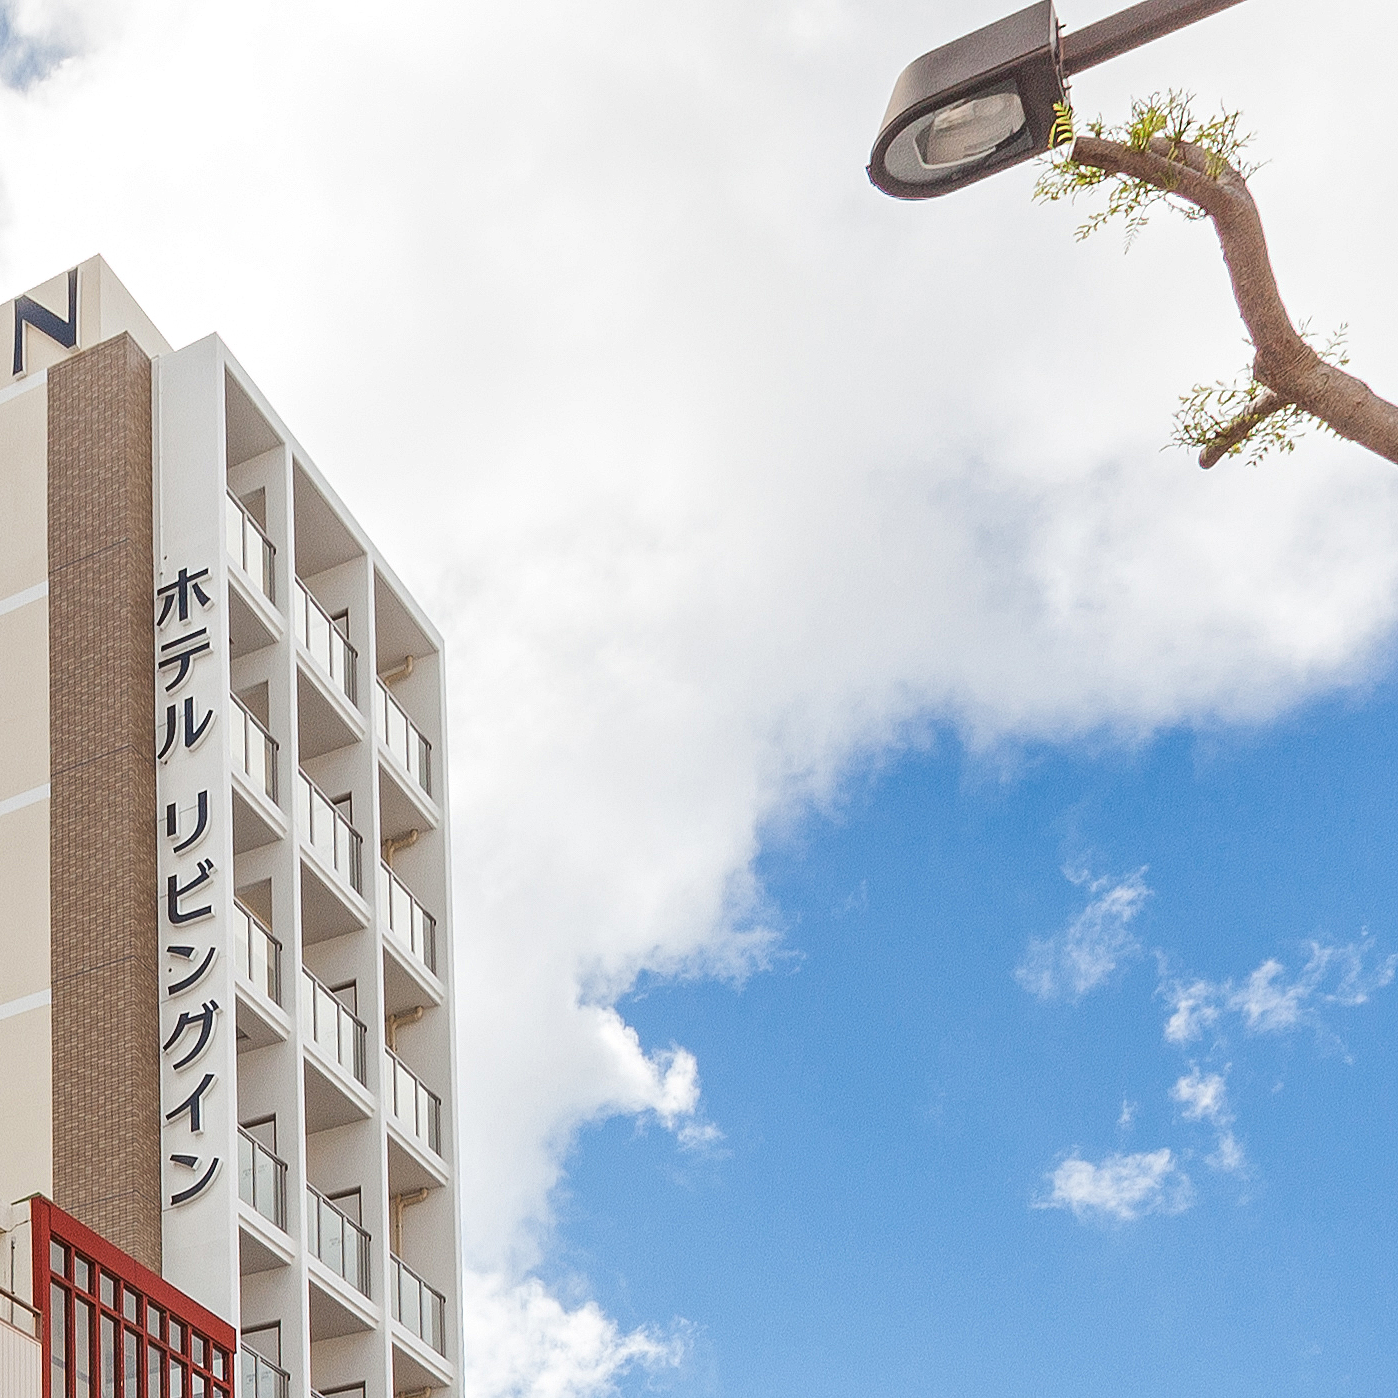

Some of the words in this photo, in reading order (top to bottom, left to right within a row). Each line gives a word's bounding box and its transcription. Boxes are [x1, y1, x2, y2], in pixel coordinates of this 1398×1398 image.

[156, 567, 215, 762] ホテル
[162, 790, 221, 1207] リビングイン
